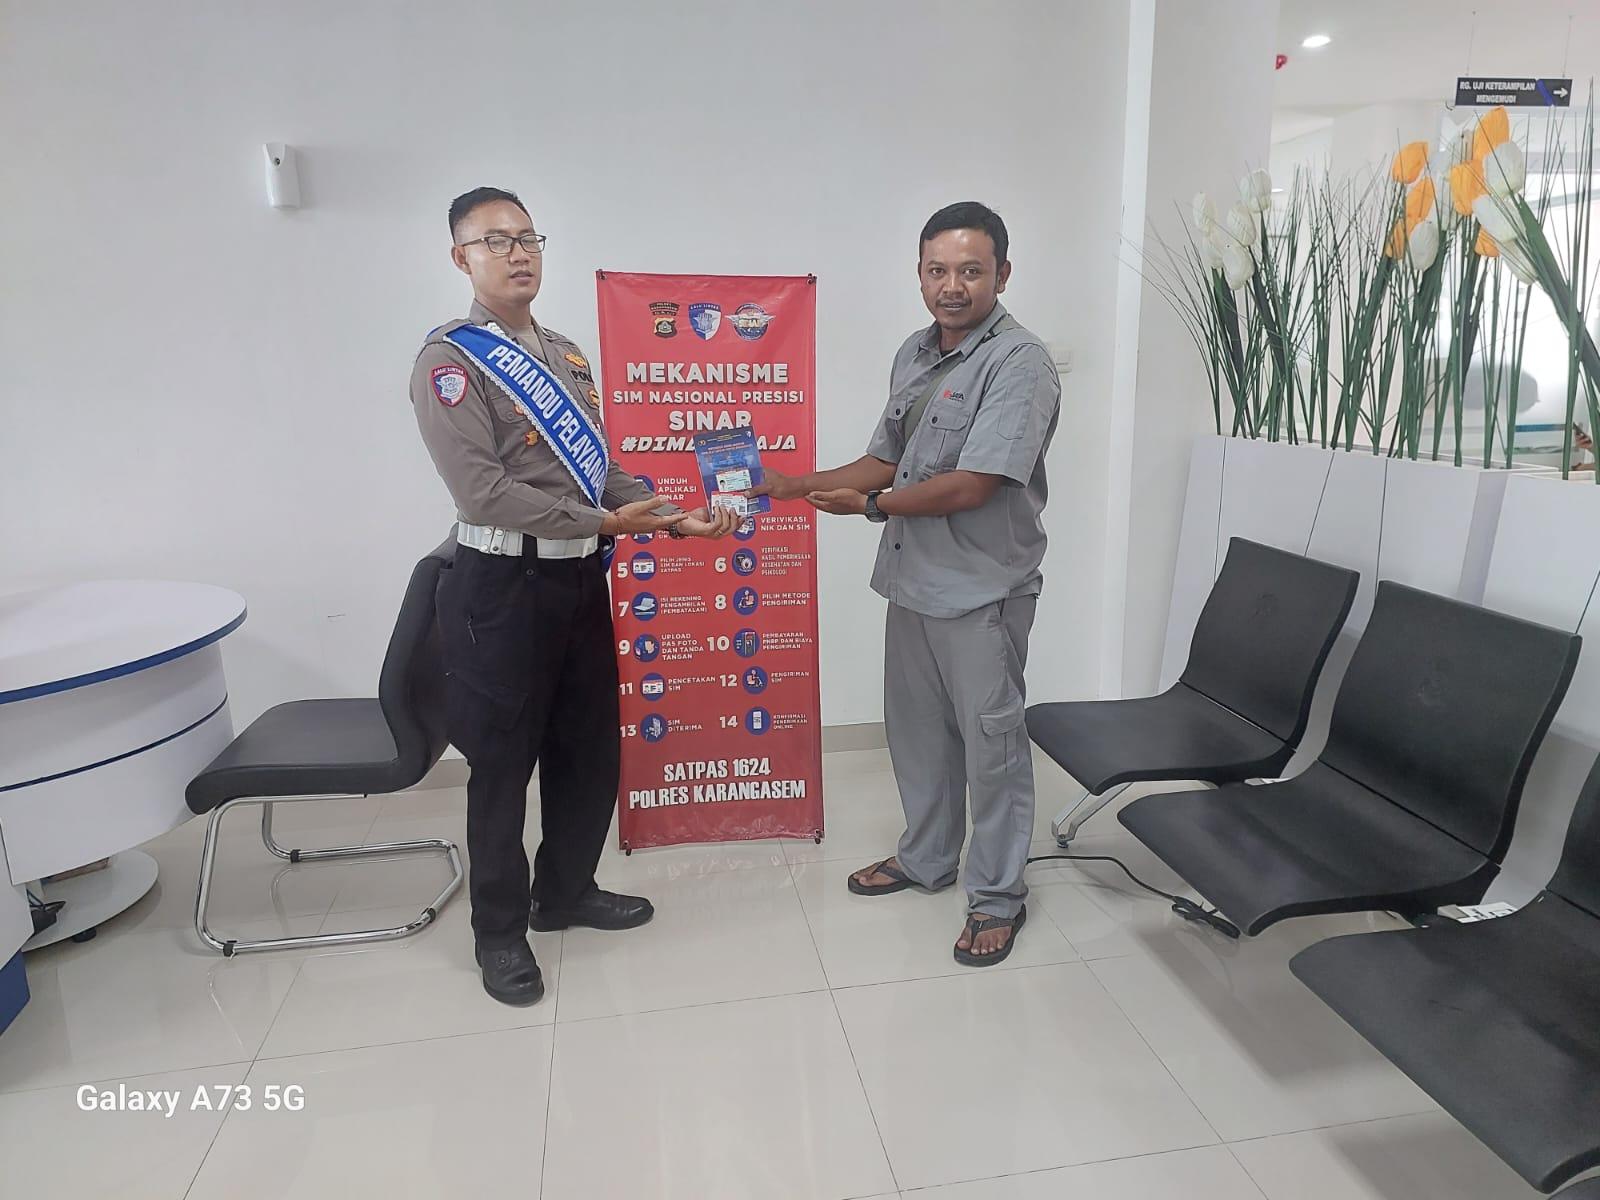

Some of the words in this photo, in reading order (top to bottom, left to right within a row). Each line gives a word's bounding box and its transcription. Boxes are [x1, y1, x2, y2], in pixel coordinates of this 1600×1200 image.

[1472, 82, 1484, 90] UJI
[1485, 82, 1536, 91] KETERAMPILAN
[626, 362, 788, 384] MEKANISME
[486, 344, 563, 420] PEMANDU
[613, 390, 642, 404] SIM
[650, 390, 737, 404] NASIONAL
[742, 390, 804, 404] PRESISI
[669, 410, 752, 431] SINAR
[761, 516, 807, 524] VERIVIKASI
[617, 562, 628, 578] 5
[714, 557, 727, 573] 6
[618, 601, 630, 617] 7
[715, 594, 727, 610] 8
[618, 639, 631, 656] 9
[707, 635, 730, 652] 10
[668, 676, 716, 684] PENCETAKAN
[720, 674, 738, 687] 12
[620, 682, 633, 696] 11
[668, 724, 703, 732] DITERIMA
[720, 715, 738, 728] 14
[620, 724, 637, 738] 13
[664, 759, 728, 782] SATPAS
[732, 757, 771, 777] 1624
[629, 786, 689, 810] POLRES
[693, 780, 806, 803] KARANGASEM
